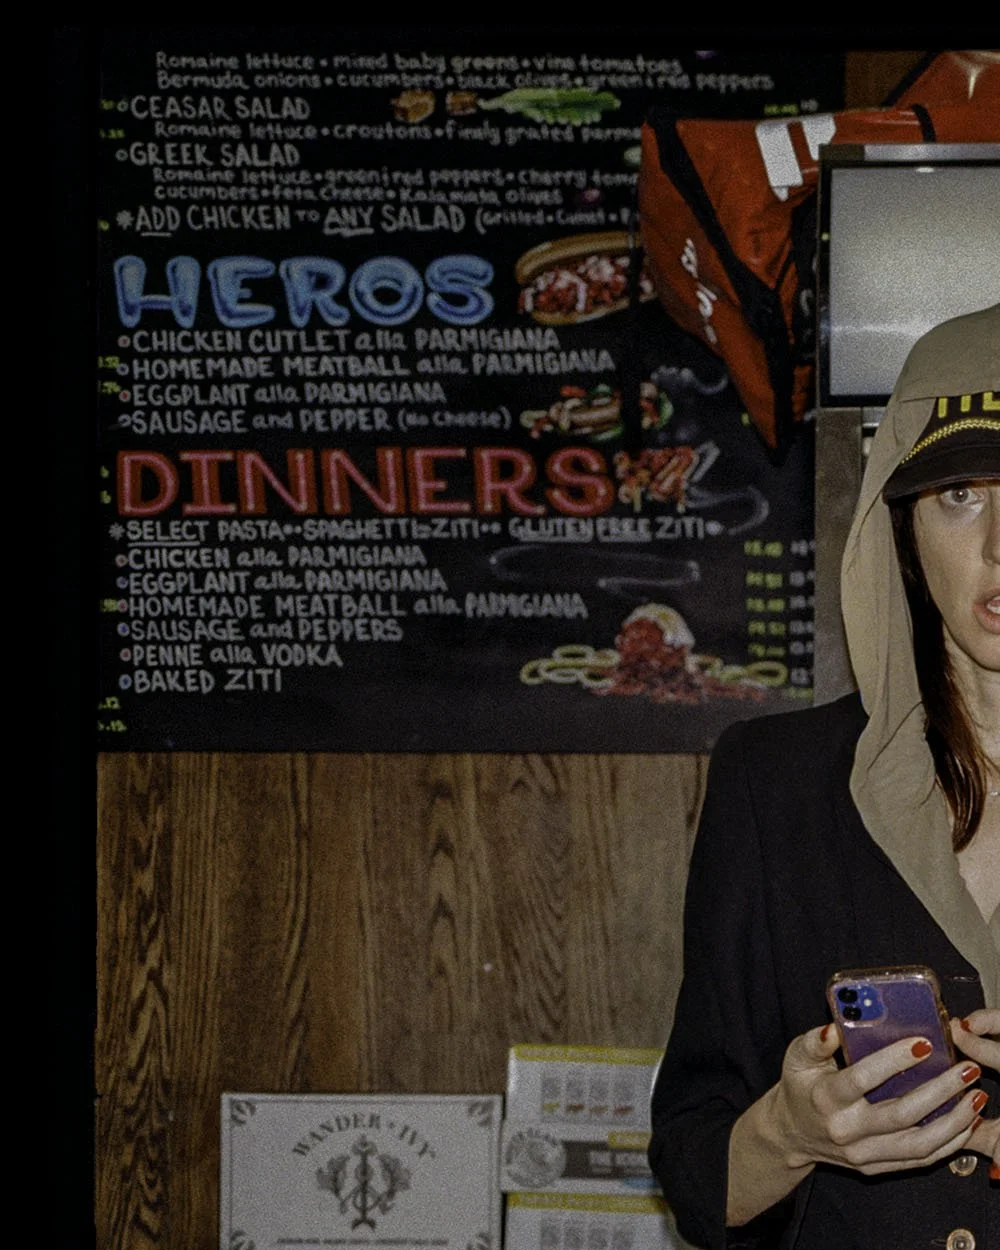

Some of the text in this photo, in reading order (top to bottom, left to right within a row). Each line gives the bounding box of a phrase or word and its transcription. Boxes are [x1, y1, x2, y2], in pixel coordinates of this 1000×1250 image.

[156, 52, 239, 70] Romaine
[247, 53, 315, 70] lettuce
[333, 52, 389, 70] mixed
[395, 52, 446, 73] baby
[451, 56, 519, 75] greens
[578, 54, 683, 76] tomatoes
[157, 70, 249, 89] Bermuda
[254, 73, 322, 88] onions
[337, 71, 446, 89] cucumbers
[130, 96, 231, 121] CEASAR
[235, 97, 311, 121] SALAD
[155, 121, 239, 138] Romaine
[249, 123, 317, 140] lettuce
[333, 122, 432, 140] croutons
[130, 142, 300, 167] GREEK SALAD
[153, 167, 235, 183] Romaine
[242, 169, 313, 185] lettuce
[154, 185, 258, 201] cucumbers
[135, 205, 181, 231] ADD
[187, 204, 290, 231] CHICKEN
[324, 205, 375, 231] ANY
[380, 205, 466, 234] SALAD
[113, 253, 496, 329] HEROS
[132, 330, 242, 352] CHICKEN
[248, 329, 351, 352] CUTLET
[414, 326, 560, 351] PARMIGIANA
[132, 356, 274, 380] HOMEMADE
[283, 354, 411, 379] MEATBALL
[472, 349, 616, 375] PARMIGIANA
[132, 383, 250, 407] EGGPLANT
[303, 381, 447, 404] PARMIGIANA
[131, 409, 248, 435] SAUSAGE
[252, 411, 294, 431] and
[300, 408, 393, 433] PEPPER
[115, 446, 615, 517] DINNERS
[126, 519, 210, 543] SELECT
[217, 519, 286, 543] PASTA
[302, 517, 416, 541] SPAGHETTI
[431, 517, 480, 541] ZITI
[656, 515, 704, 540] ZITI
[127, 546, 231, 570] CHICKEN
[287, 545, 427, 568] PARMIGIANA
[128, 571, 250, 596] EGGPLANT
[303, 568, 447, 593] PARMIGIANA
[128, 596, 266, 620] HOMEMADE
[275, 595, 408, 619] MEATBALL
[130, 618, 405, 643] SAUSAGE and PEPPERS
[132, 644, 203, 668] PENNE
[261, 643, 344, 668] VODKA
[133, 668, 283, 695] BAKED ZITI
[292, 1113, 437, 1159] WANDER IVY
